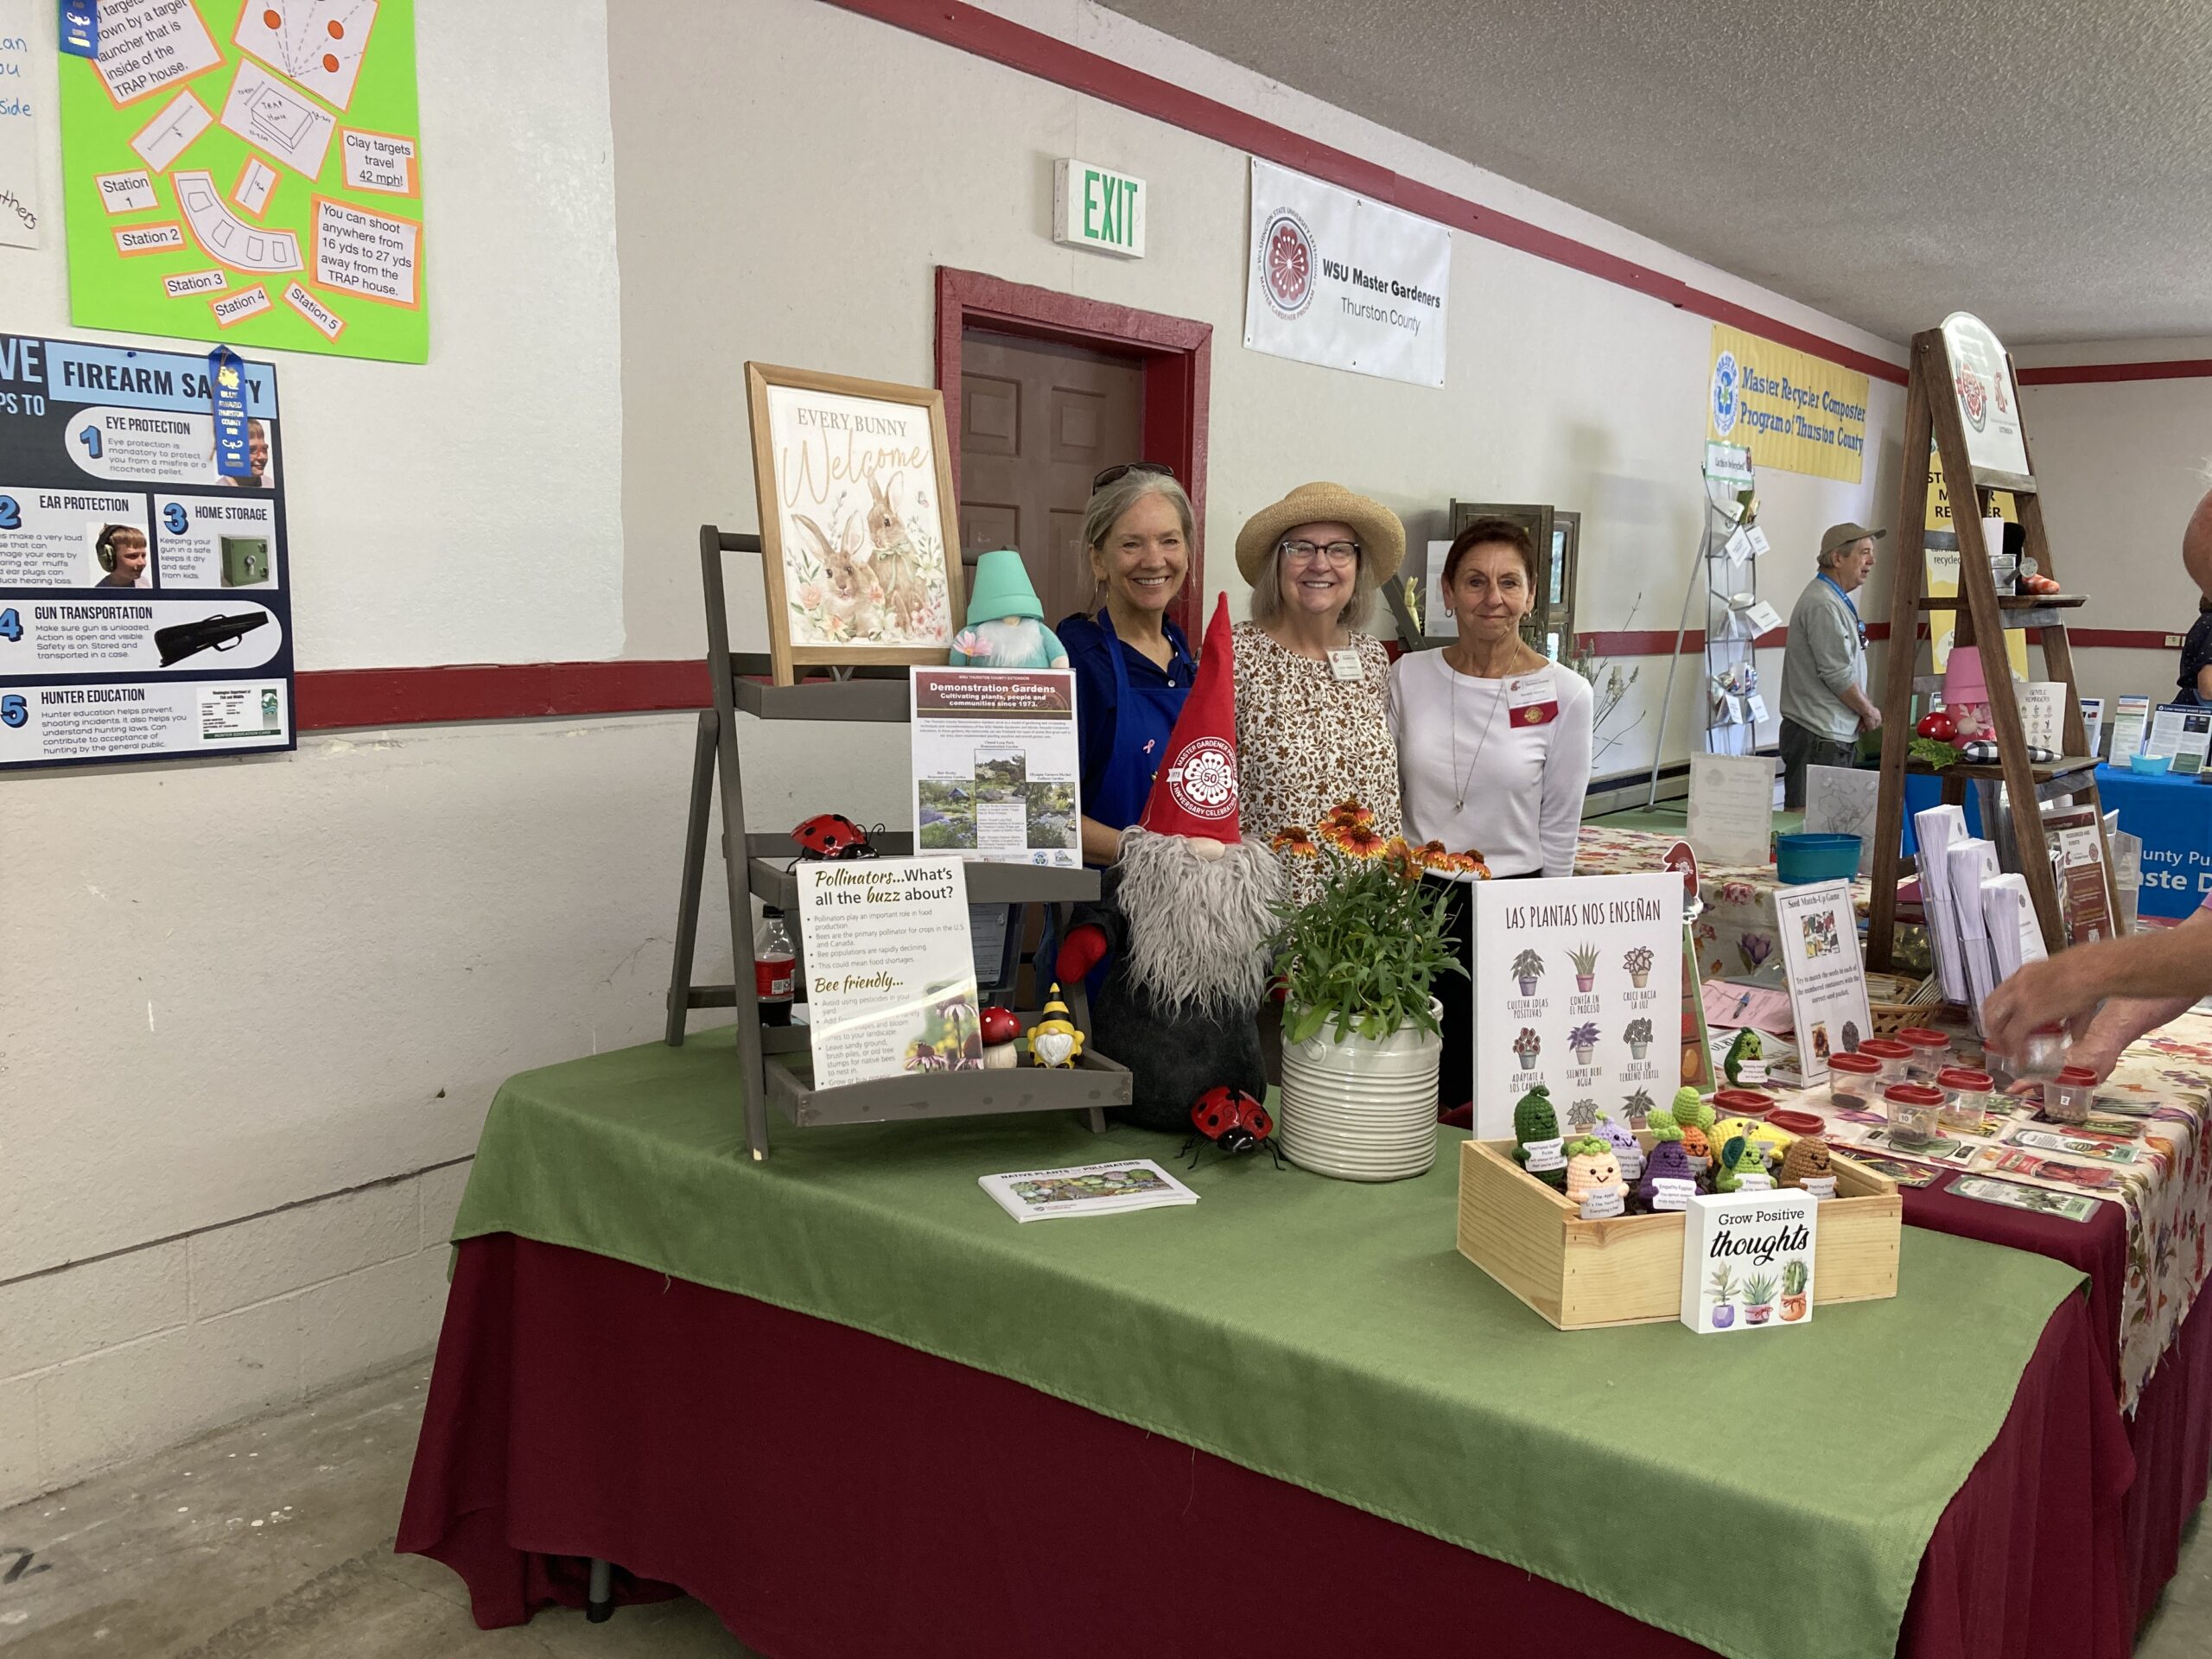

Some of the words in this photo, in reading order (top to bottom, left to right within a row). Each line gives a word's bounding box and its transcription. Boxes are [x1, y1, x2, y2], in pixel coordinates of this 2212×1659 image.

[129, 14, 143, 29] by
[145, 11, 154, 22] a
[155, 0, 188, 16] target
[145, 25, 170, 42] that
[168, 20, 182, 32] is
[105, 60, 140, 80] inside
[142, 50, 155, 67] of
[155, 44, 175, 60] the
[114, 75, 147, 98] TRAP
[149, 60, 188, 84] house.
[346, 135, 371, 151] Clay
[373, 140, 411, 156] targets
[365, 155, 395, 168] travel
[103, 178, 149, 193] Station
[359, 169, 373, 182] 42
[376, 173, 404, 187] mph!
[125, 197, 133, 208] 1
[1084, 169, 1138, 248] EXIT
[323, 203, 343, 219] You
[346, 212, 366, 226] can
[369, 218, 401, 234] shoot
[122, 232, 168, 246] Station
[170, 228, 180, 240] 2
[322, 222, 376, 244] anywhere
[378, 236, 404, 251] from
[322, 237, 335, 250] 16
[339, 242, 359, 257] yds
[362, 248, 373, 258] to
[376, 249, 389, 263] 27
[392, 255, 412, 269] yds
[321, 254, 350, 271] away
[353, 260, 378, 276] from
[381, 268, 398, 280] the
[168, 276, 212, 292] Station
[214, 274, 223, 284] 3
[327, 269, 359, 286] TRAP
[362, 277, 398, 296] house.
[1323, 258, 1349, 283] WSU
[1352, 268, 1389, 294] Master
[1391, 280, 1440, 308] Gardeners
[215, 296, 254, 317] Station
[257, 289, 264, 301] 4
[291, 288, 328, 323] Station
[328, 319, 339, 330] 5
[1341, 296, 1388, 323] Thurston
[1389, 309, 1421, 337] County
[63, 360, 173, 397] FIREARM
[22, 394, 45, 416] TO
[1742, 366, 1780, 397] Master
[1782, 377, 1820, 410] Recycler
[1821, 391, 1866, 423] Composter
[106, 416, 126, 430] EYE
[129, 418, 191, 435] PROTECTION
[797, 407, 849, 430] EVERY
[855, 415, 906, 437] BUNNY
[1740, 401, 1783, 435] Program
[1796, 415, 1834, 445] Thurston
[1837, 427, 1865, 457] County
[79, 424, 104, 459] 1
[109, 448, 157, 457] mandatory
[127, 440, 171, 449] protection
[783, 423, 930, 509] Welcome
[0, 494, 22, 530] 2
[40, 495, 61, 509] EAR
[64, 496, 130, 512] PROTECTION
[195, 505, 224, 519] HOME
[226, 506, 268, 521] STORAGE
[163, 502, 189, 536] 3
[35, 607, 57, 620] GUN
[60, 607, 153, 620] TRANSPORTATION
[0, 607, 24, 643] 4
[41, 690, 85, 705] HUNTER
[87, 688, 145, 703] EDUCATION
[930, 683, 1008, 692] Demonstration
[1012, 684, 1056, 693] Gardens
[940, 692, 980, 701] Cultivating
[1, 694, 29, 728] 5
[73, 709, 115, 717] education
[117, 708, 140, 716] helps
[1178, 745, 1198, 766] MASTER
[1196, 741, 1229, 752] GARDENER
[1204, 772, 1217, 784] 50
[1173, 782, 1206, 815] ANNIVERSARY
[816, 892, 832, 906] all
[837, 891, 861, 905] the
[867, 886, 900, 903] buzz
[905, 886, 954, 900] about?
[1788, 899, 1800, 908] Seed
[1827, 893, 1840, 901] Game
[1506, 906, 1525, 929] LAS
[1530, 905, 1578, 927] PLANTAS
[1583, 903, 1605, 925] NOS
[1610, 898, 1661, 923] ENSEÑAN
[815, 977, 839, 993] Bee
[843, 971, 904, 994] friendly...
[1507, 1001, 1530, 1010] CULTIVA
[1532, 998, 1548, 1007] IDEAS
[1570, 1006, 1576, 1015] EL
[1577, 1004, 1600, 1014] PROCESO
[1592, 995, 1599, 1003] EN
[1631, 1001, 1637, 1009] LA
[1639, 1000, 1649, 1009] LUZ
[1514, 1008, 1542, 1019] POSITIVAS
[1644, 1061, 1651, 1071] EN
[1577, 1077, 1592, 1087] AGUA
[1719, 1213, 1753, 1225] Grow
[1756, 1207, 1804, 1223] Positive
[1710, 1224, 1809, 1266] thoughts
